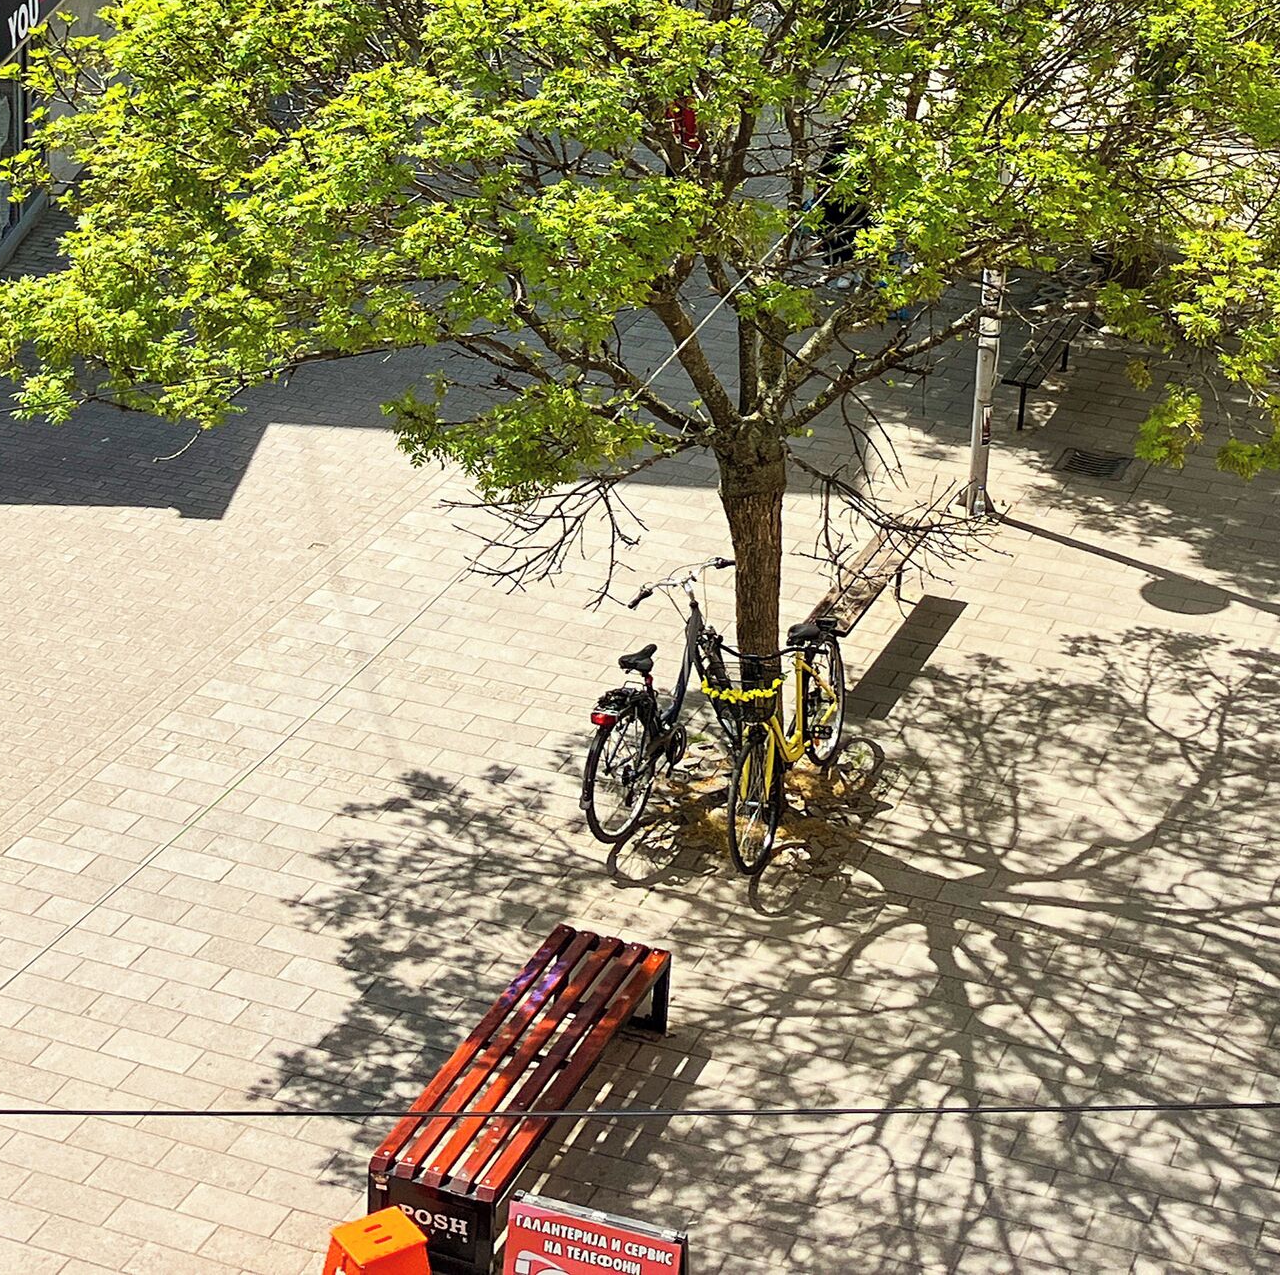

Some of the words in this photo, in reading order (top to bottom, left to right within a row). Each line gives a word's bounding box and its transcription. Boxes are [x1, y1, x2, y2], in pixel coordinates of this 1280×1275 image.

[516, 1214, 608, 1250] ГАЛАНТЕРИЈА
[611, 1238, 621, 1252] И
[624, 1241, 674, 1266] СЕРВИС
[544, 1240, 562, 1256] НА
[566, 1245, 642, 1275] ТЕЛЕФОНИ
